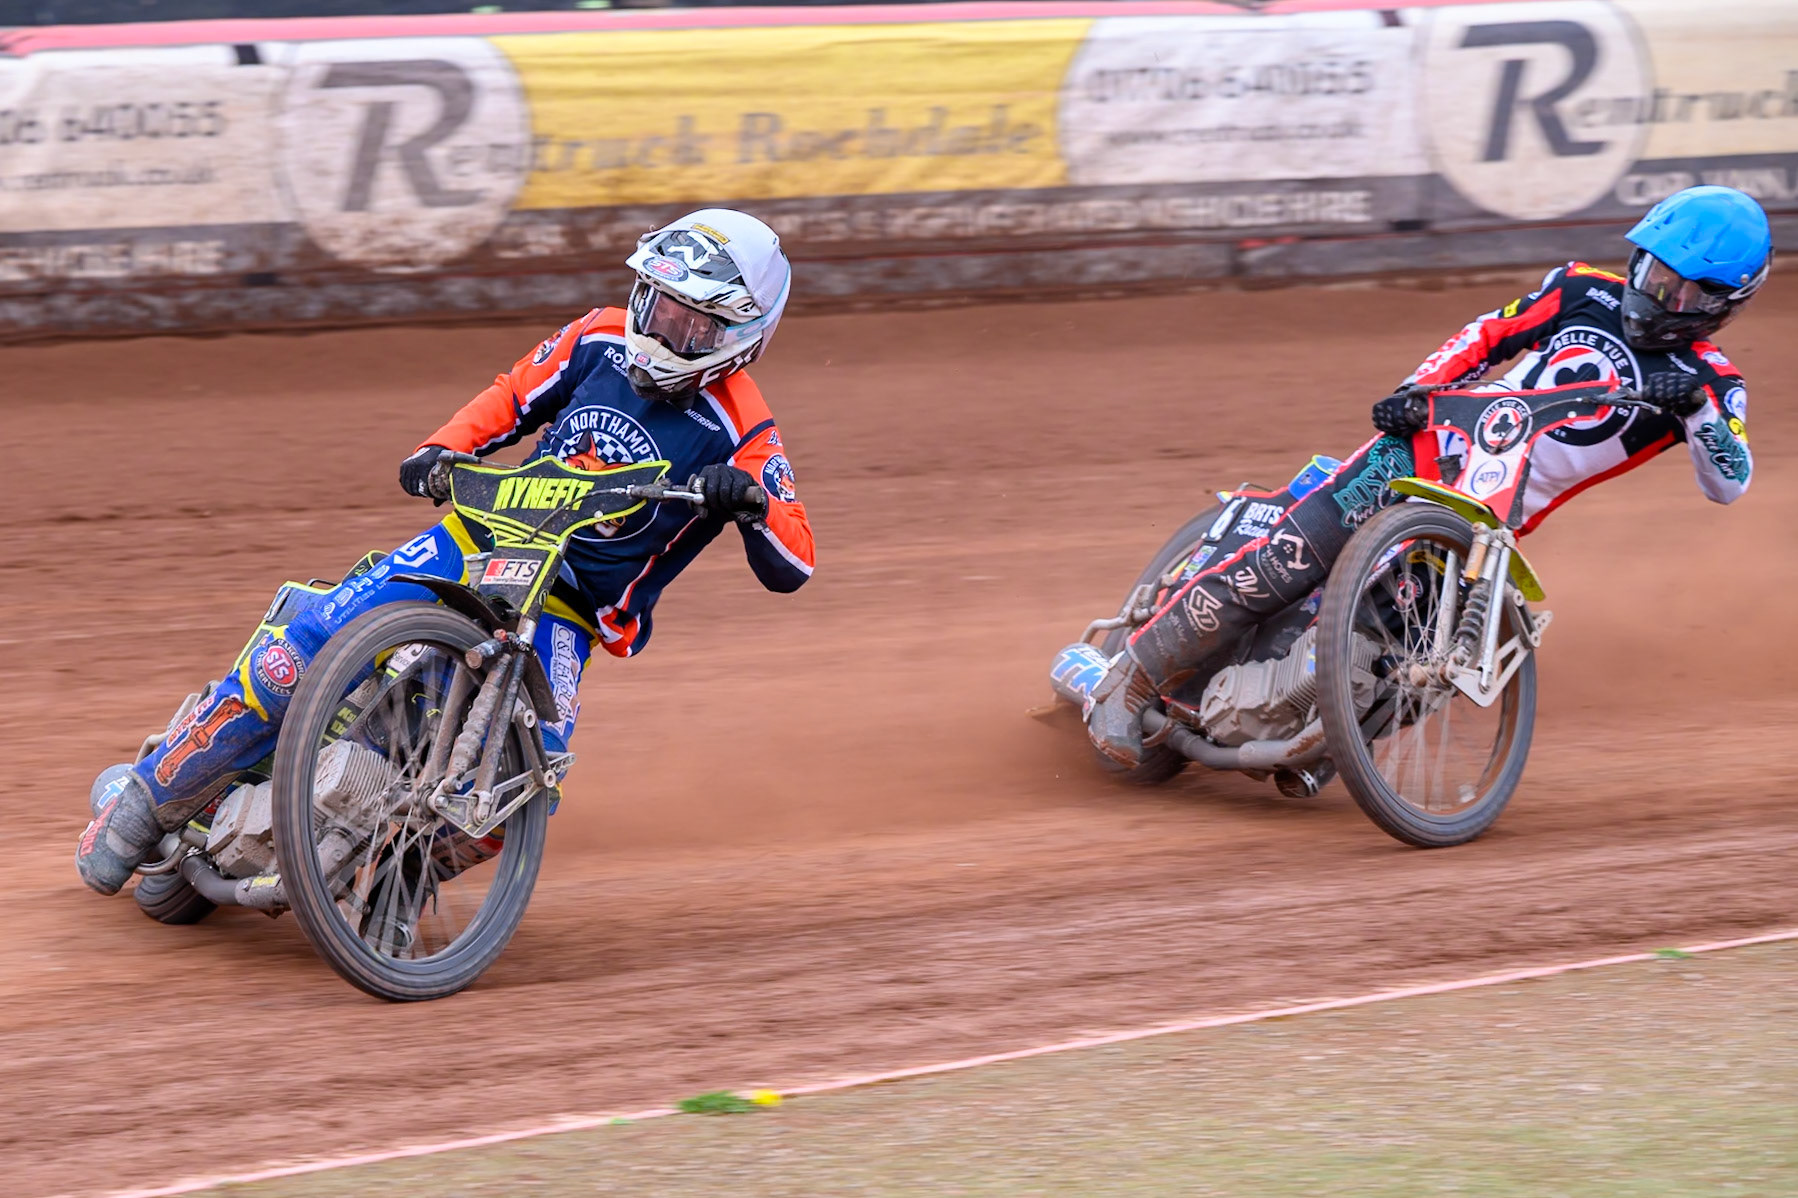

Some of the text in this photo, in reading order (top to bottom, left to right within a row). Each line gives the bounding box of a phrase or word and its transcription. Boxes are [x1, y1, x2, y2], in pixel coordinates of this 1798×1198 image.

[1554, 332, 1599, 350] BELLE
[1602, 341, 1630, 370] VUE
[1333, 446, 1415, 513] BOSTON
[1243, 502, 1284, 525] BRTS
[500, 560, 539, 578] FTS
[266, 650, 291, 680] STS
